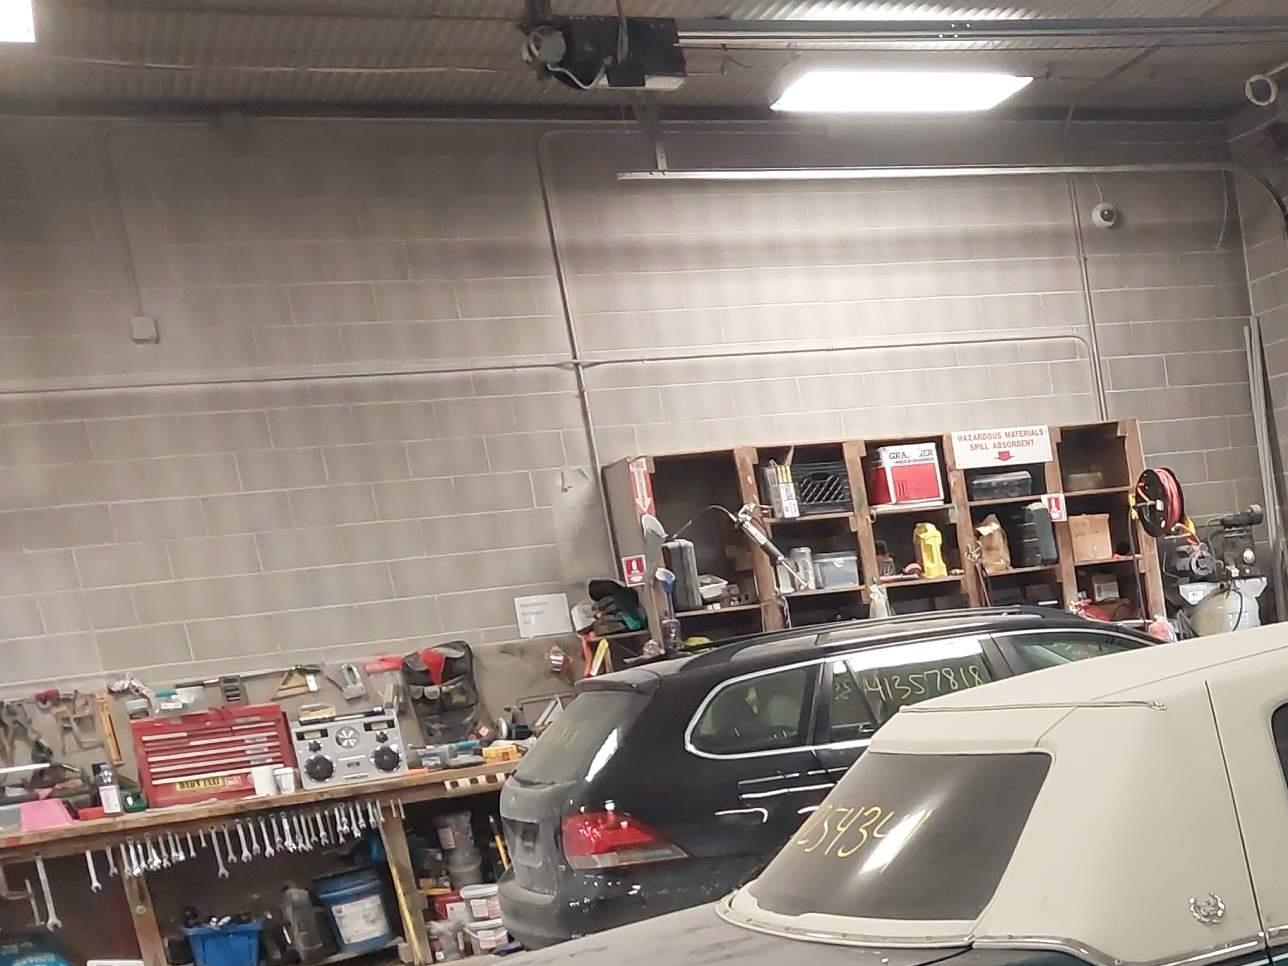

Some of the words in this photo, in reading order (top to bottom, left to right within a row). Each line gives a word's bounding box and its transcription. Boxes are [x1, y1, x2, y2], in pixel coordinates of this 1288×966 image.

[957, 432, 1002, 442] HAZARDOUS
[1004, 428, 1044, 439] MATERIALS
[969, 442, 989, 451] SPILL
[992, 439, 1035, 449] ABSORBENT
[888, 448, 934, 460] GRAER
[863, 665, 983, 701] 41357818
